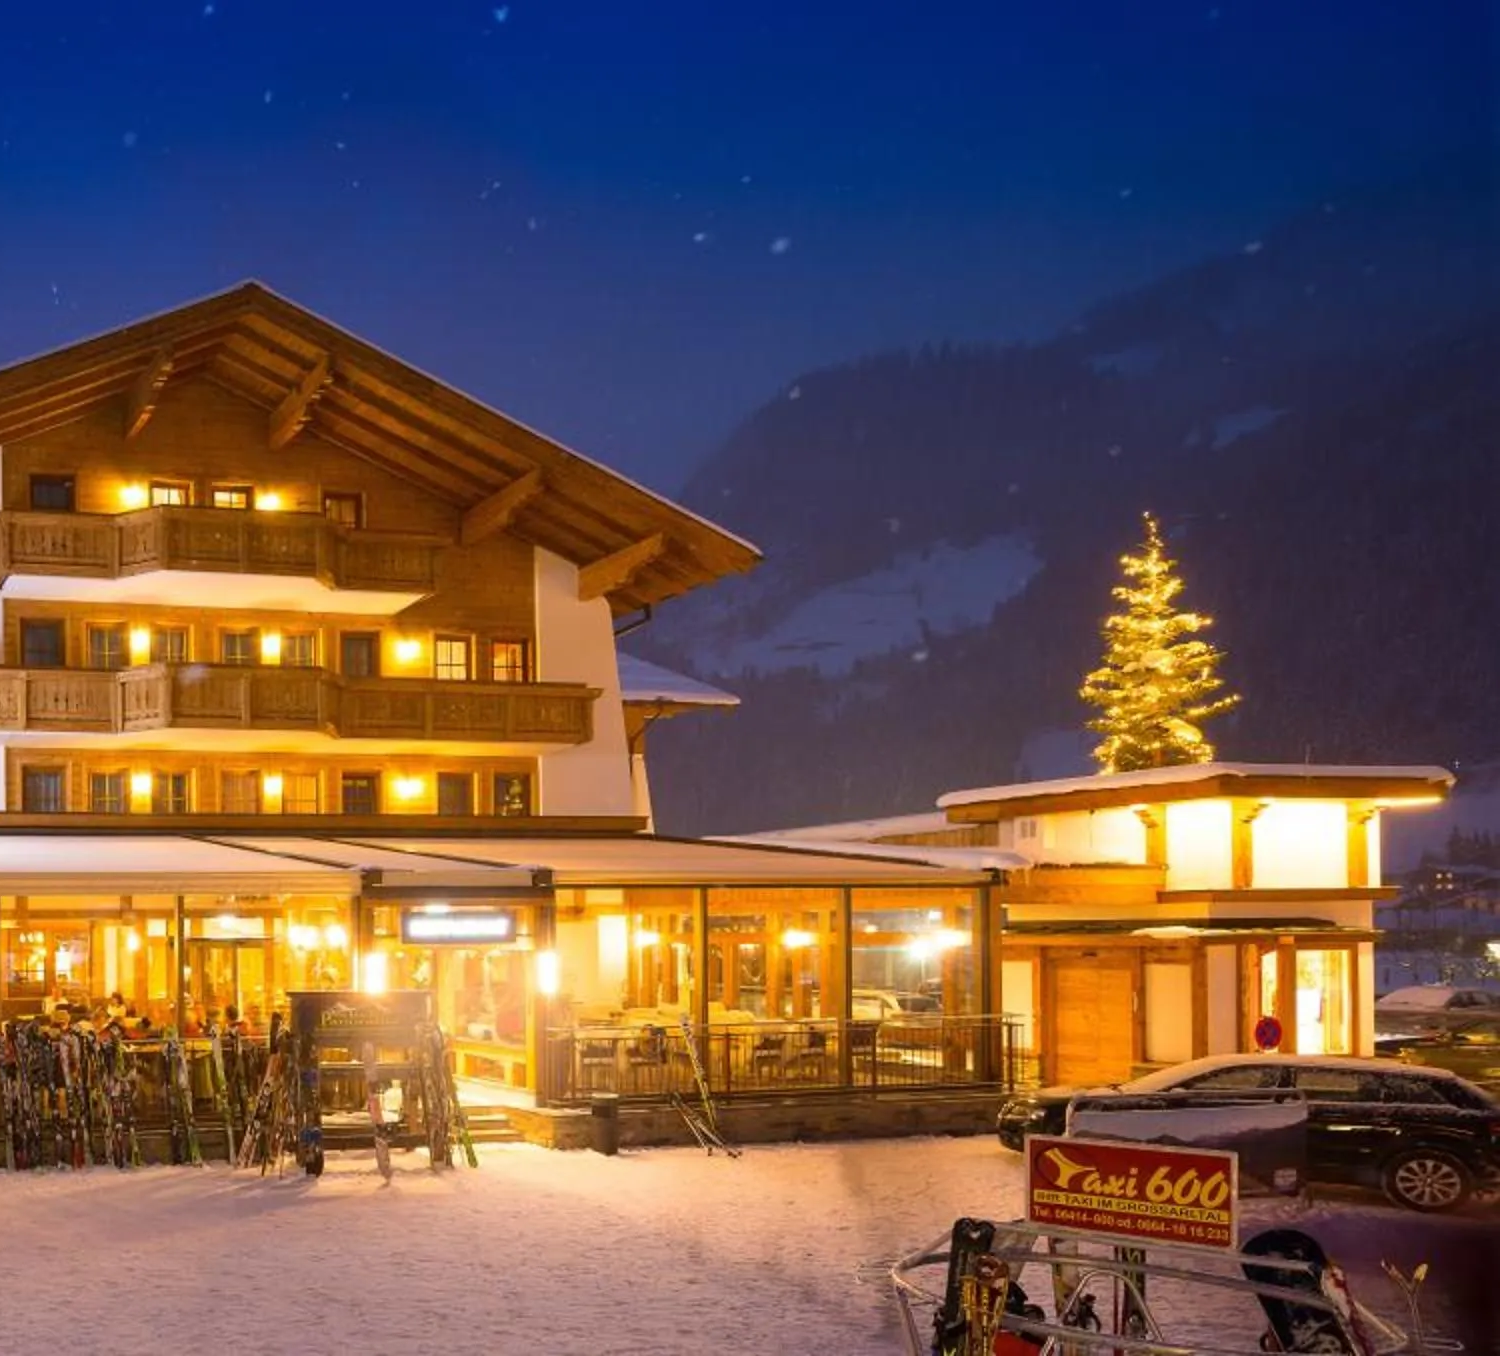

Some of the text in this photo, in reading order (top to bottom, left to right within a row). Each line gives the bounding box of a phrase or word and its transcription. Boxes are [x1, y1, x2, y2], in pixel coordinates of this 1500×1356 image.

[1044, 1148, 1229, 1208] Taxi 600
[1065, 1194, 1093, 1207] TAXI
[1097, 1197, 1113, 1209] IM
[1115, 1200, 1228, 1221] GROSSARLTAL
